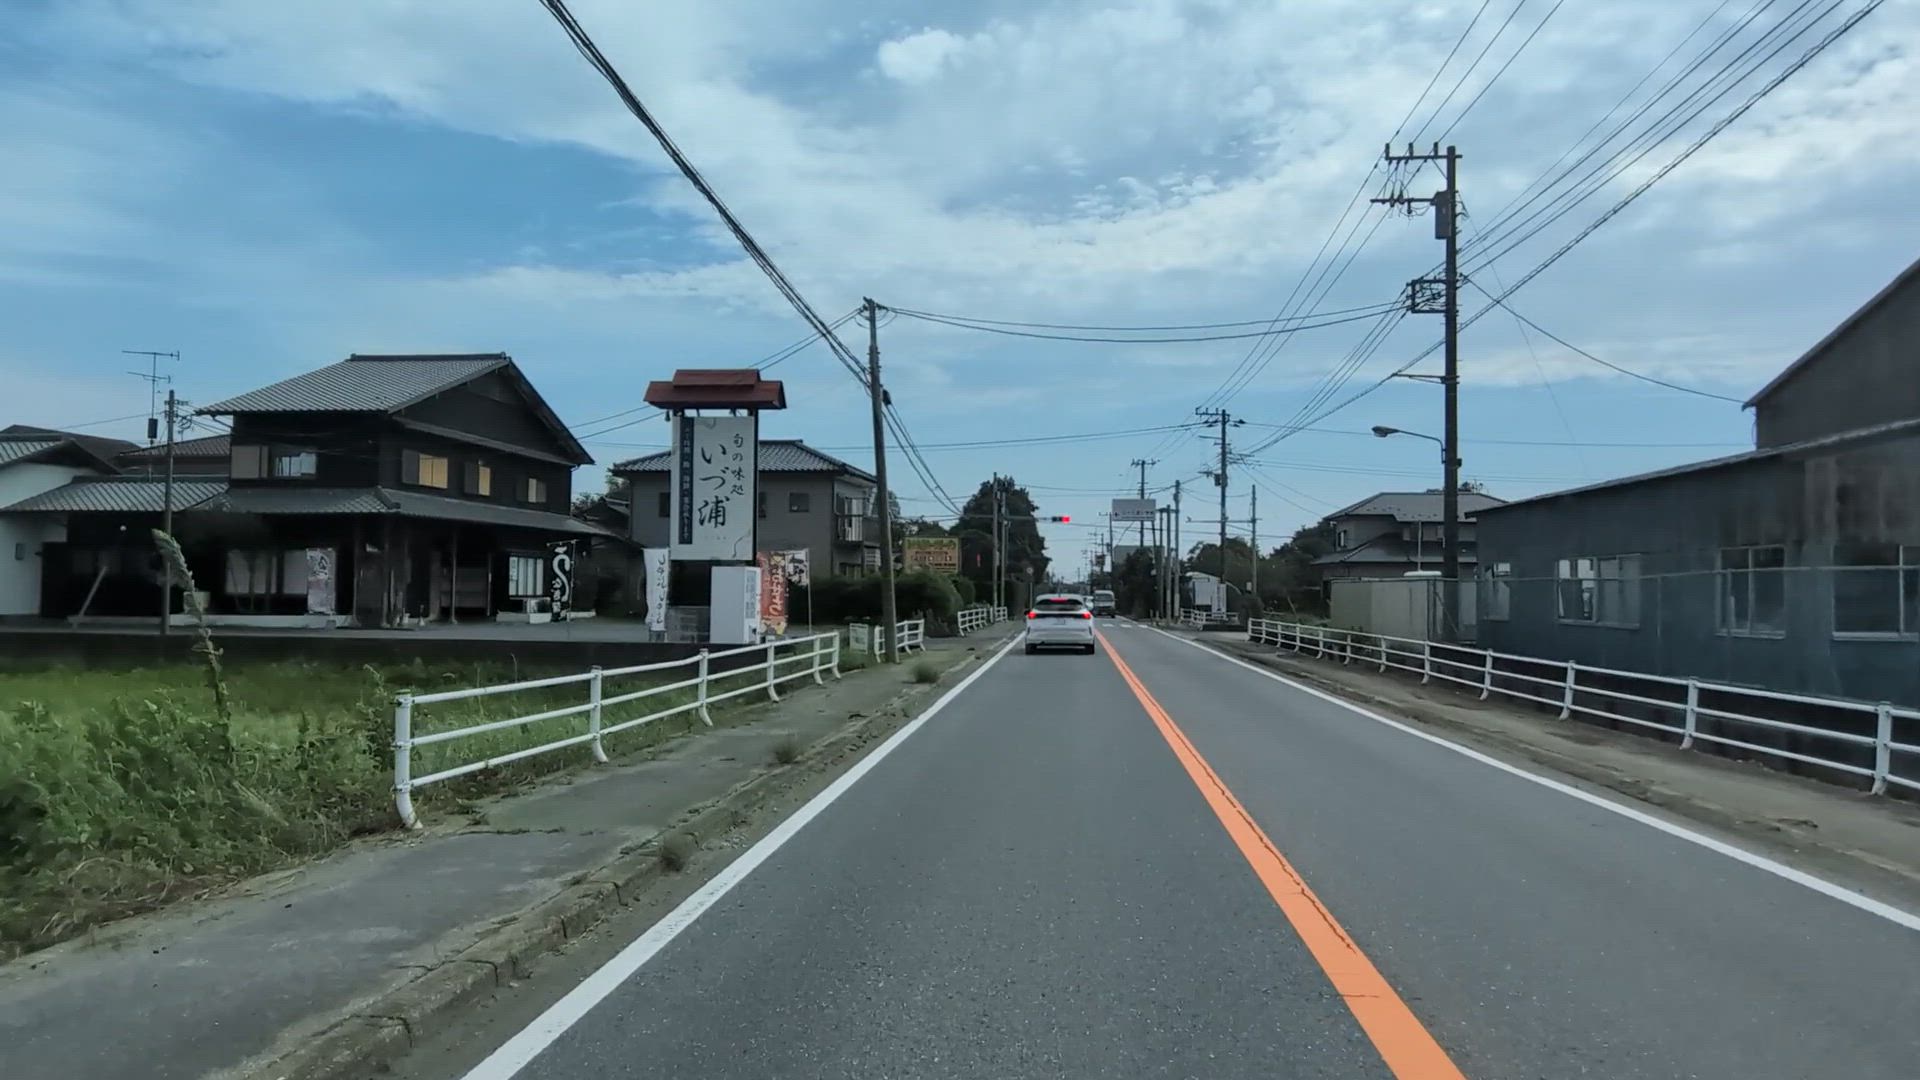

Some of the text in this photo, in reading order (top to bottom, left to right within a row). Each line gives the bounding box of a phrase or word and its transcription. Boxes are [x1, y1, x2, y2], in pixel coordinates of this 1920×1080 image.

[698, 444, 730, 528] いづ浦
[730, 433, 745, 496] 旬の味処
